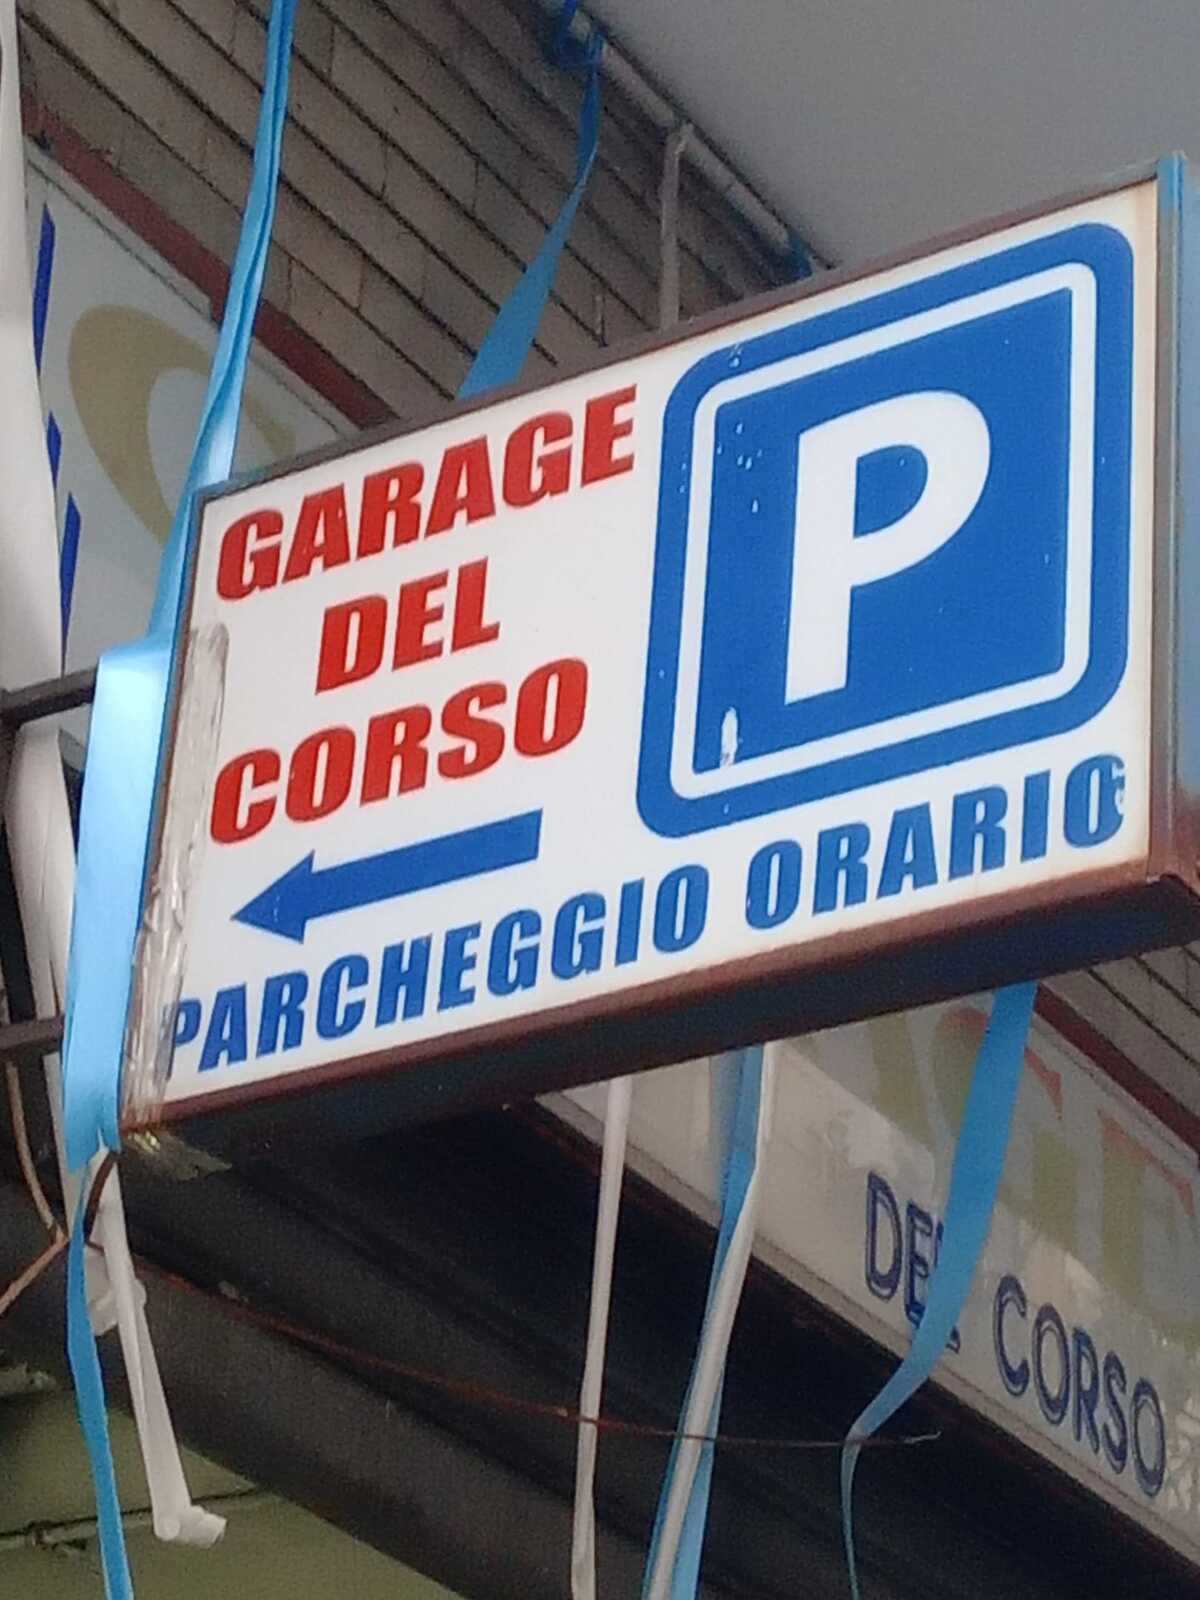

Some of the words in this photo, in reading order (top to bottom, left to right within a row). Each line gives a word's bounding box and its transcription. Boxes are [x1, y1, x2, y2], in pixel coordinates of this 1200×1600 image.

[216, 383, 637, 600] GARAGE
[785, 390, 991, 705] P
[210, 657, 588, 844] CORSO
[315, 557, 500, 695] DEL
[156, 864, 709, 1082] PARCHEGGIO
[745, 753, 1126, 930] ORARIO
[865, 1170, 960, 1353] DE
[993, 1274, 1166, 1497] CORSO
